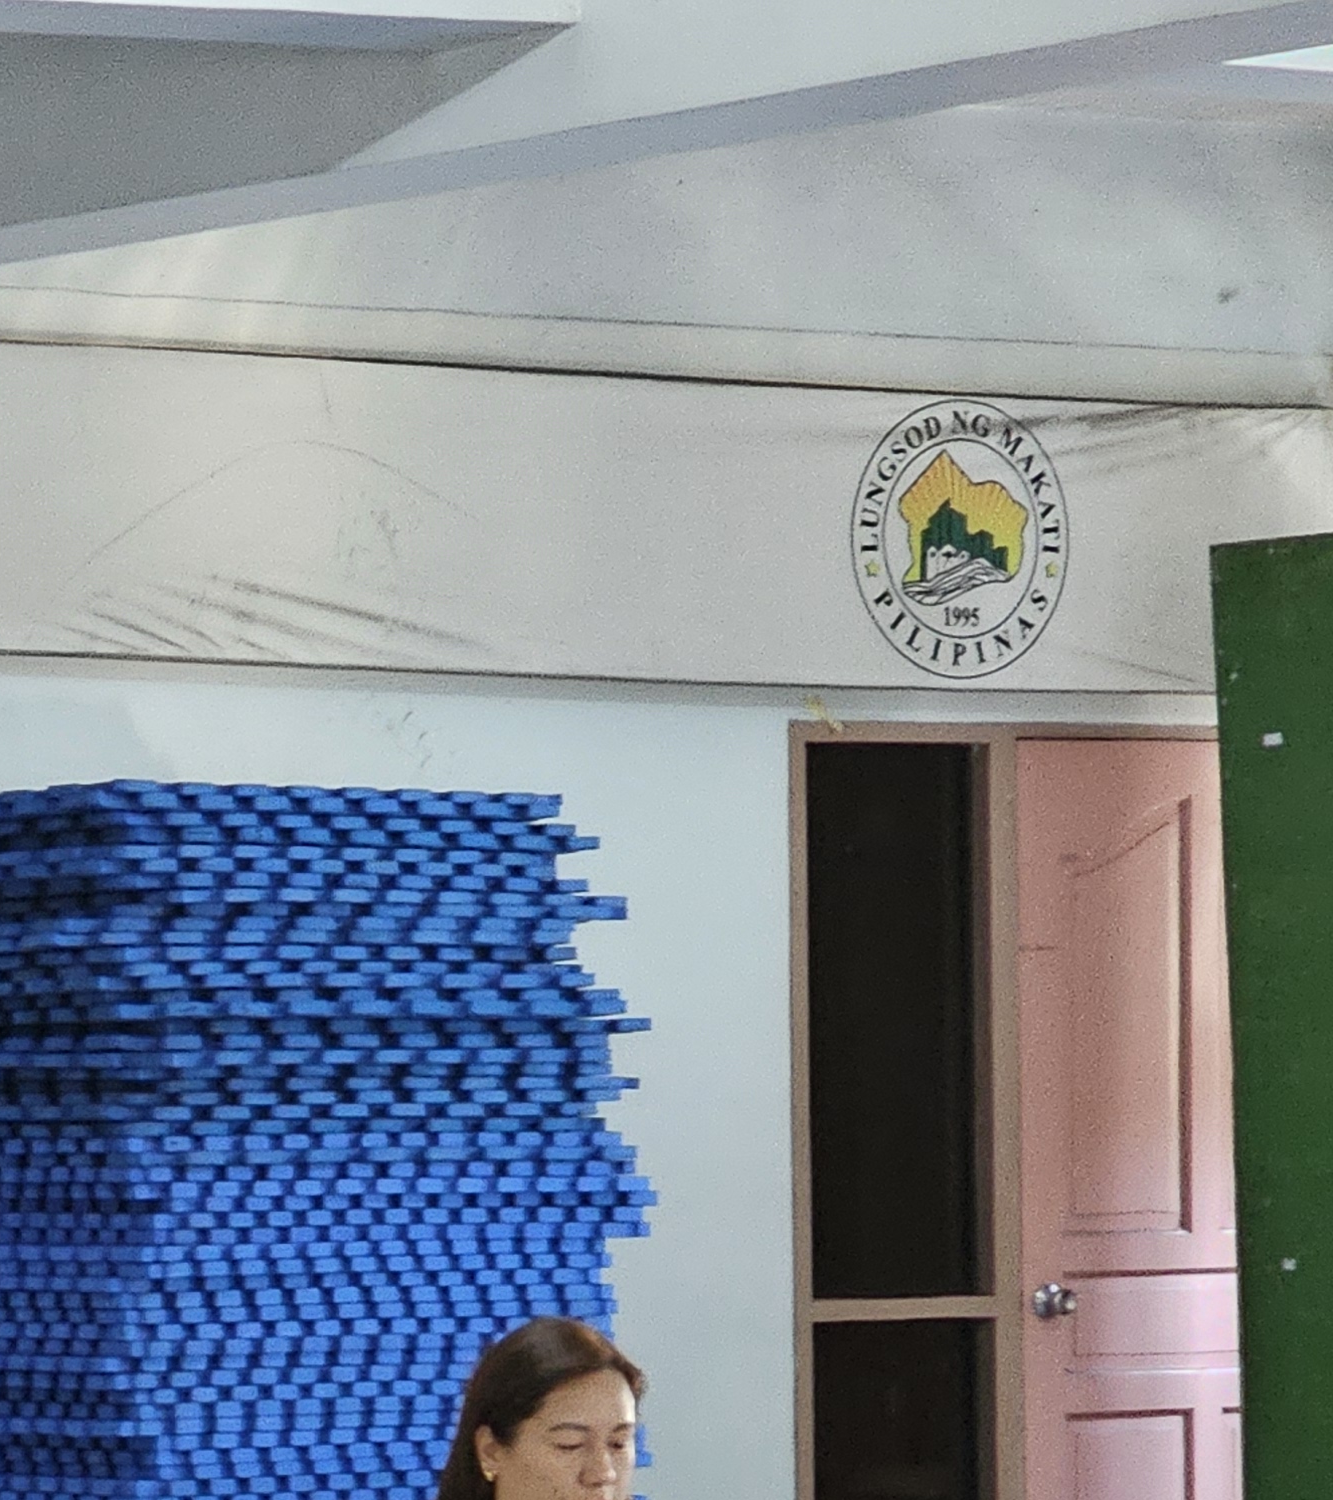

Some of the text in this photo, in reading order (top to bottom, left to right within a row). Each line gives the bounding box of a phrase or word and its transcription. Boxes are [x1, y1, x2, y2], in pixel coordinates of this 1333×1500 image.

[860, 410, 1062, 555] LUNGSOD NG MAKATI
[873, 588, 1049, 667] PILIPINAS
[943, 606, 981, 628] 1995
